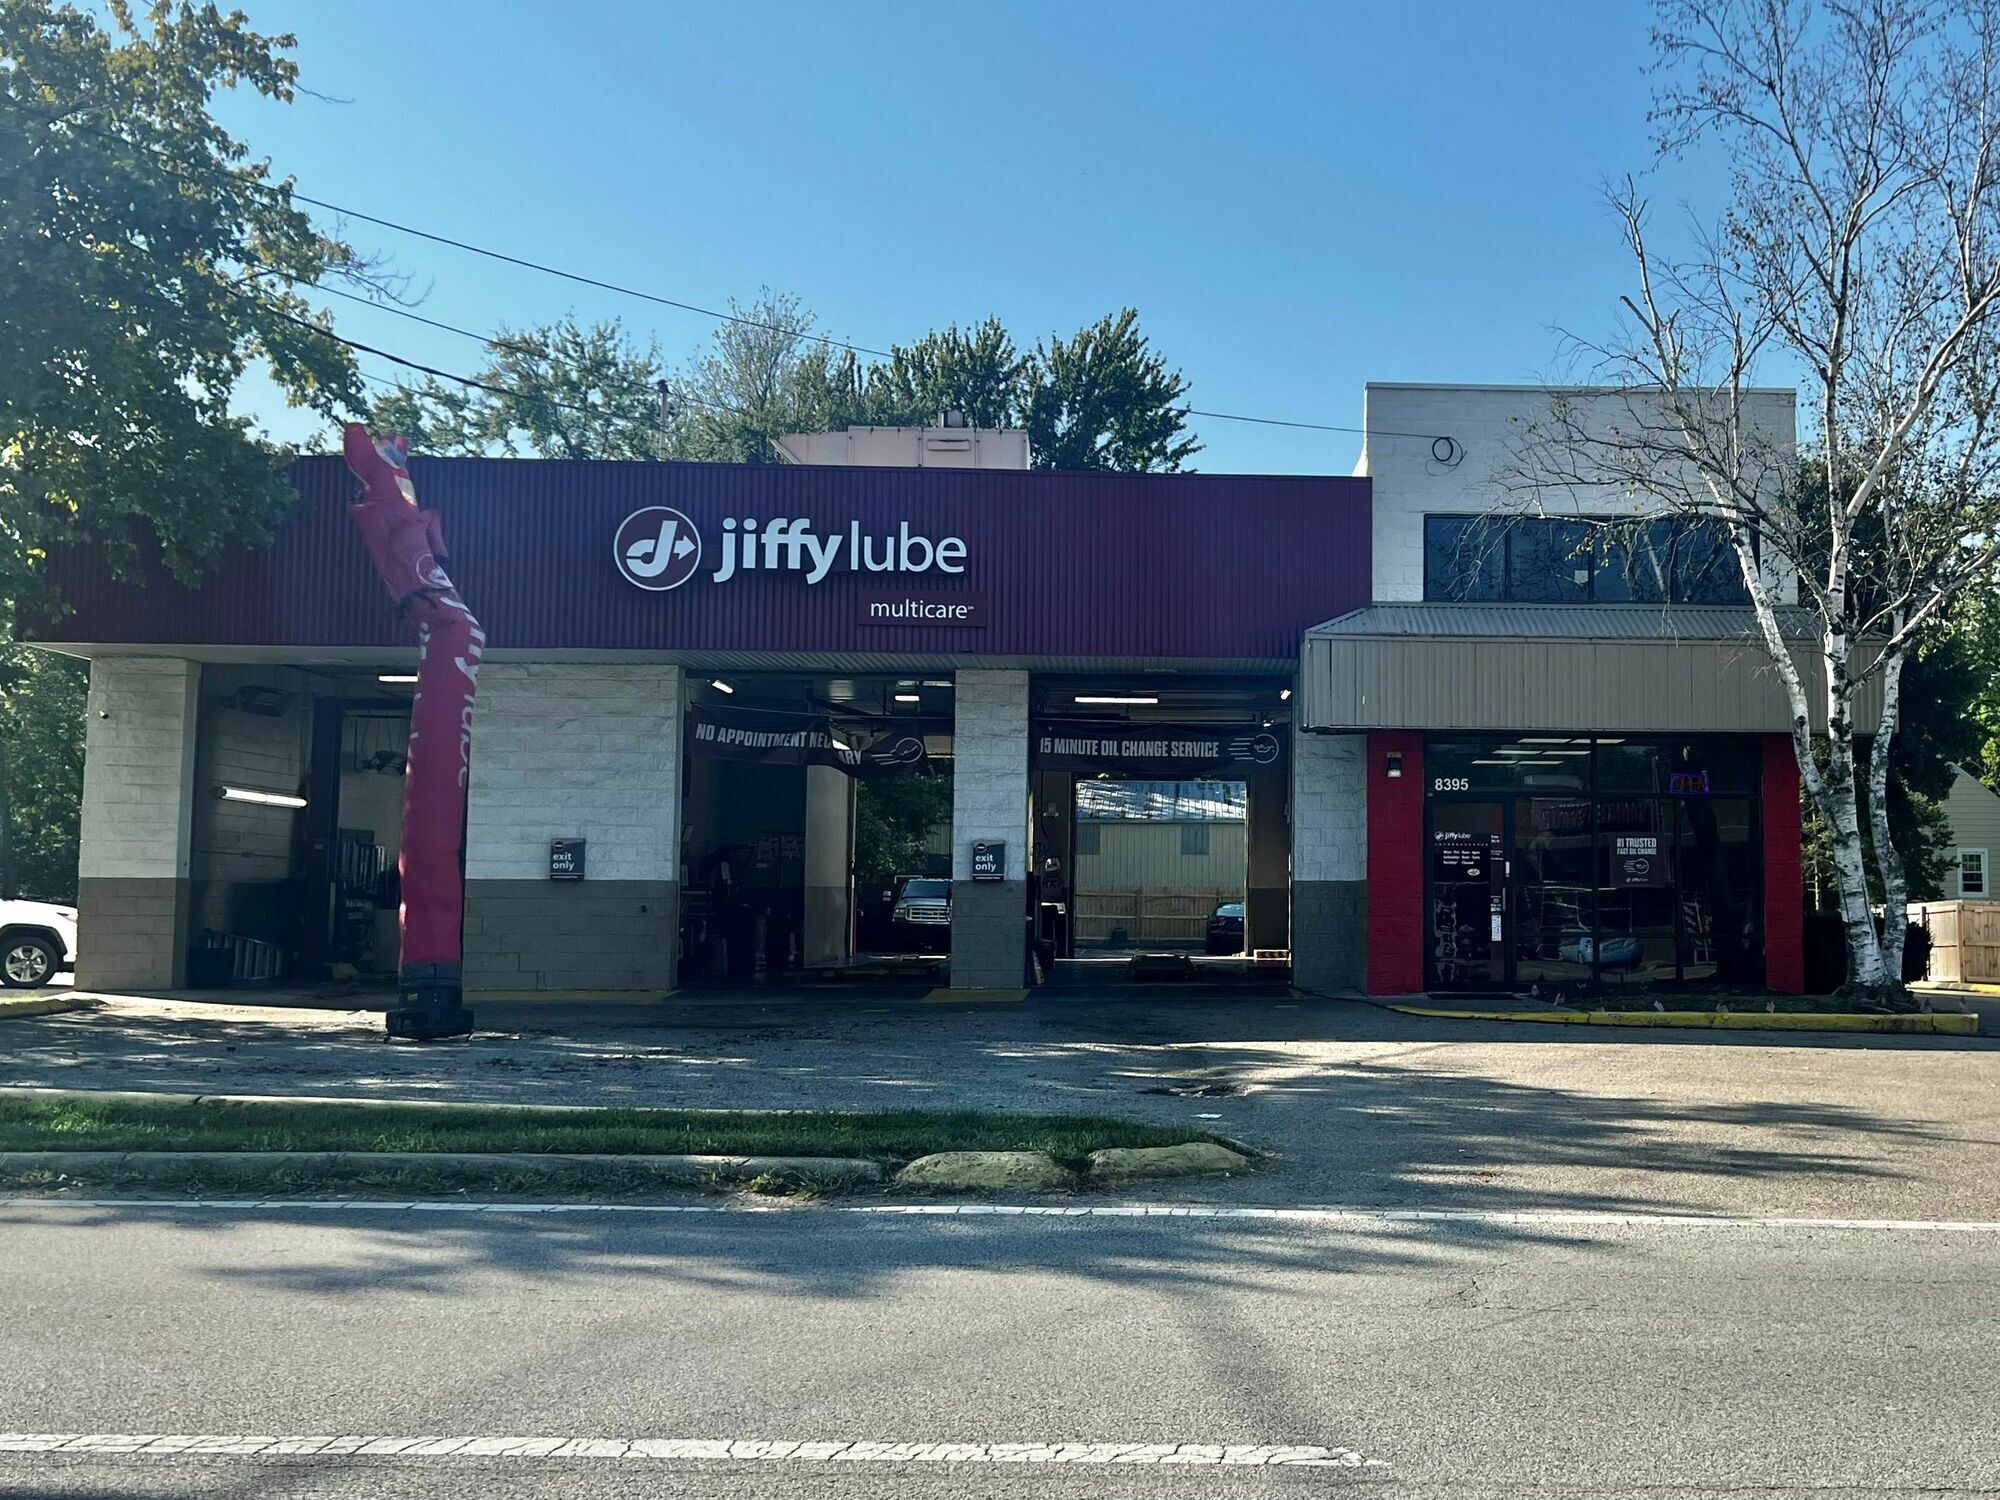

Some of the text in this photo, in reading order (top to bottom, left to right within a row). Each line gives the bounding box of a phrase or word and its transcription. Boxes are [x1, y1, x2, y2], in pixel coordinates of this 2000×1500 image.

[713, 518, 967, 585] jiffy lube
[870, 598, 969, 619] multicare
[696, 723, 715, 741] NO
[717, 727, 807, 748] APPOINTMENT
[1054, 738, 1098, 756] MINUTE
[1101, 740, 1119, 757] OIL
[1121, 740, 1168, 757] CHANGE
[1171, 741, 1219, 758] SERVICE
[1434, 778, 1469, 791] 8395
[1625, 837, 1657, 848] TRUSTED
[553, 851, 572, 861] exit
[975, 853, 994, 862] exit
[552, 860, 575, 871] only
[975, 862, 997, 872] only
